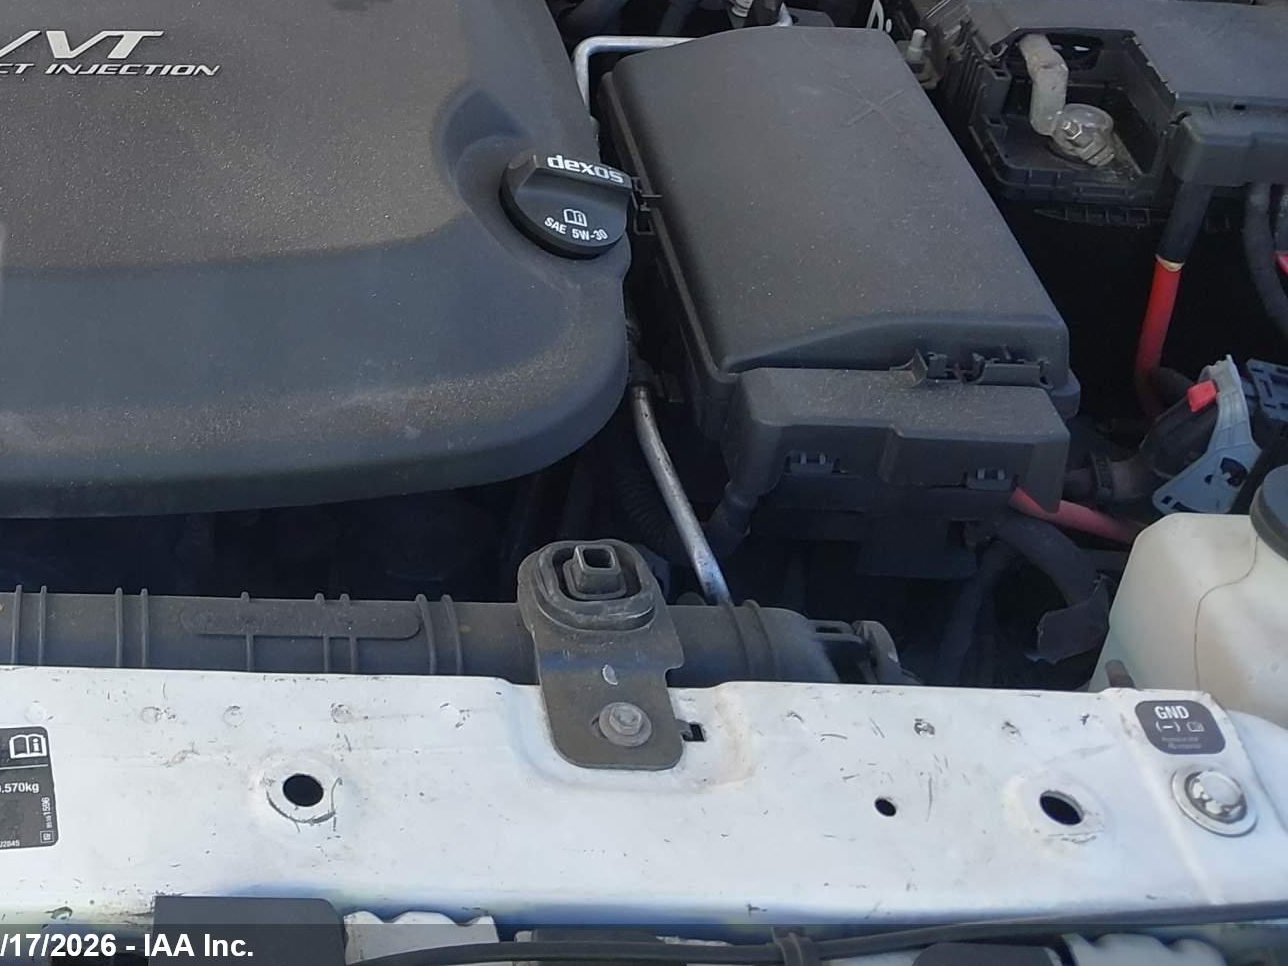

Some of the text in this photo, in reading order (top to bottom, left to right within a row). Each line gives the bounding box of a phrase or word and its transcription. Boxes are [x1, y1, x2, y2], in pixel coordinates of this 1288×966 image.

[44, 64, 221, 77] INJECTION
[547, 155, 624, 184] dexos
[544, 217, 608, 241] SAE 5W-30
[1154, 705, 1190, 720] GND
